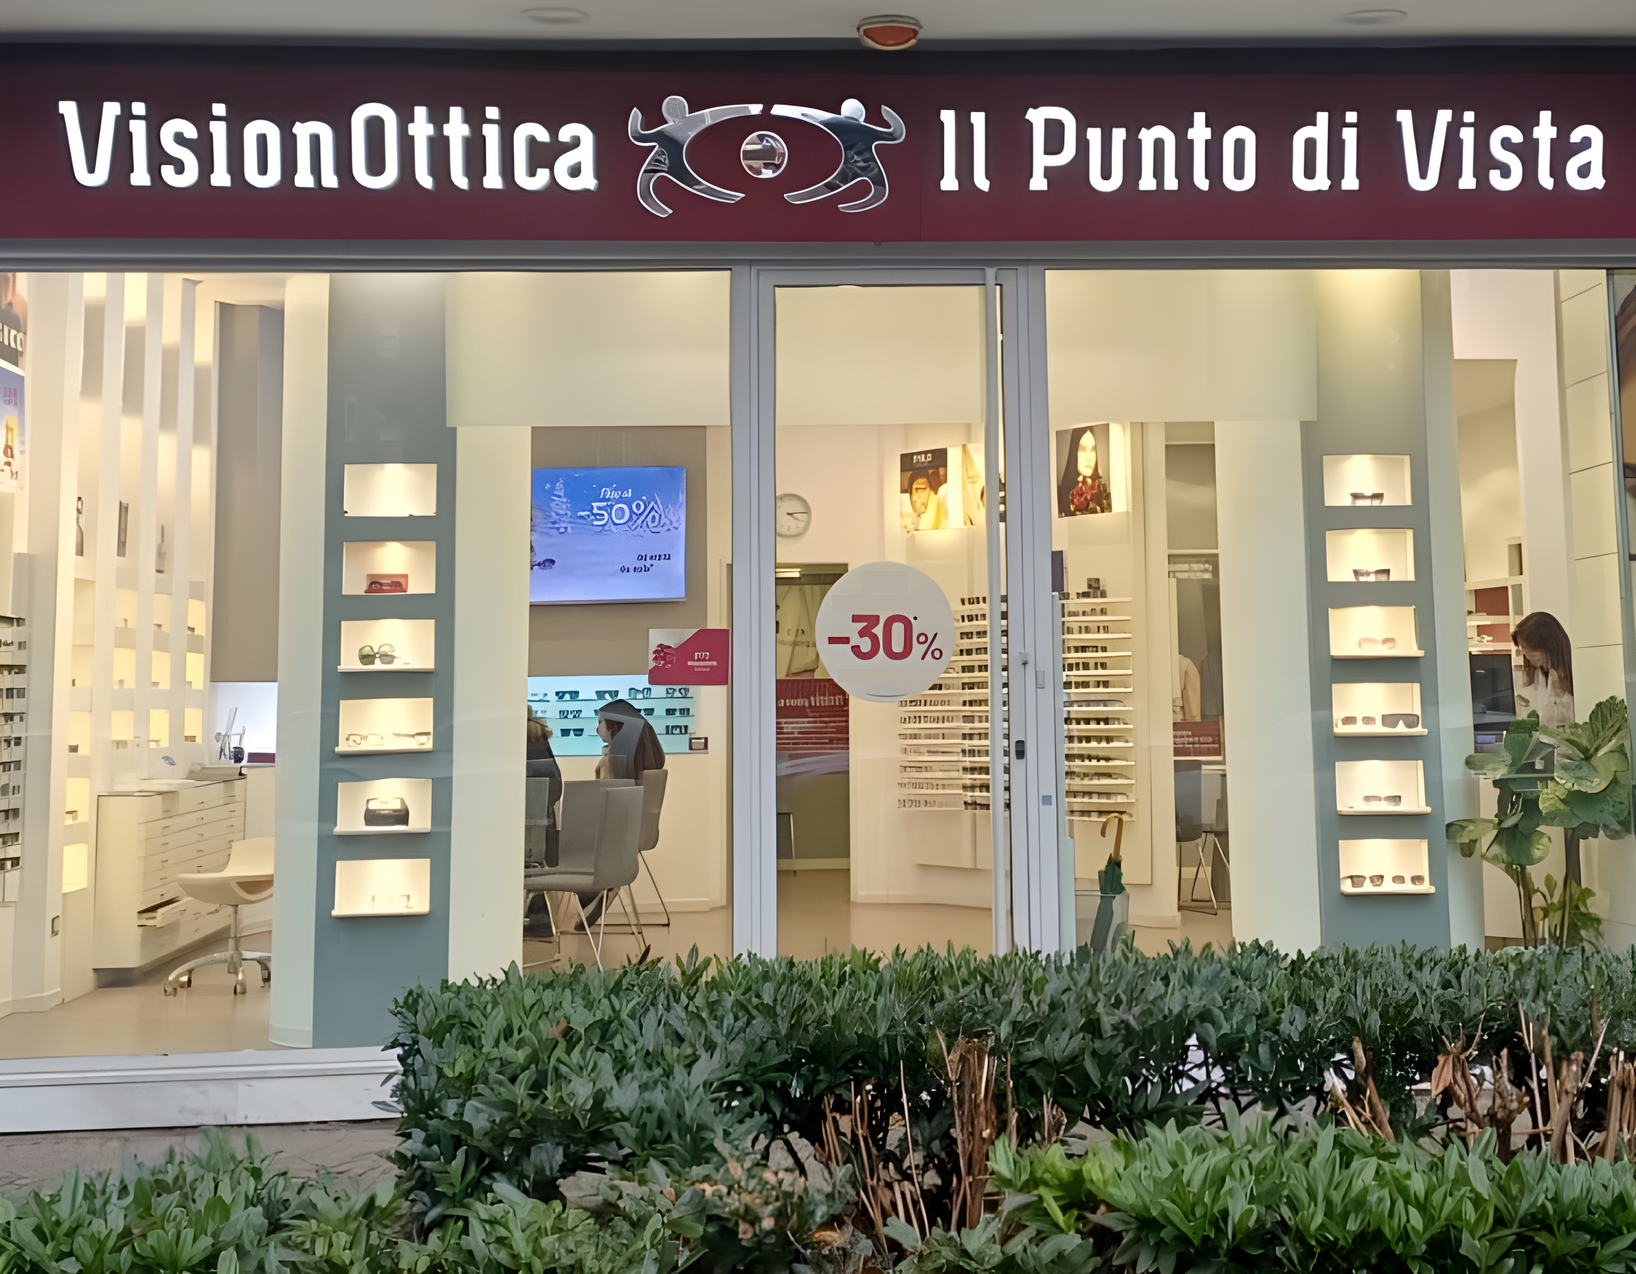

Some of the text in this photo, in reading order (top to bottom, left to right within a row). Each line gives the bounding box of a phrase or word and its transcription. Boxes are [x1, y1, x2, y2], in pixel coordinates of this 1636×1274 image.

[58, 100, 600, 192] VisionOttica
[1024, 106, 1258, 193] Punto
[1291, 111, 1361, 192] di
[1396, 109, 1607, 192] Vista
